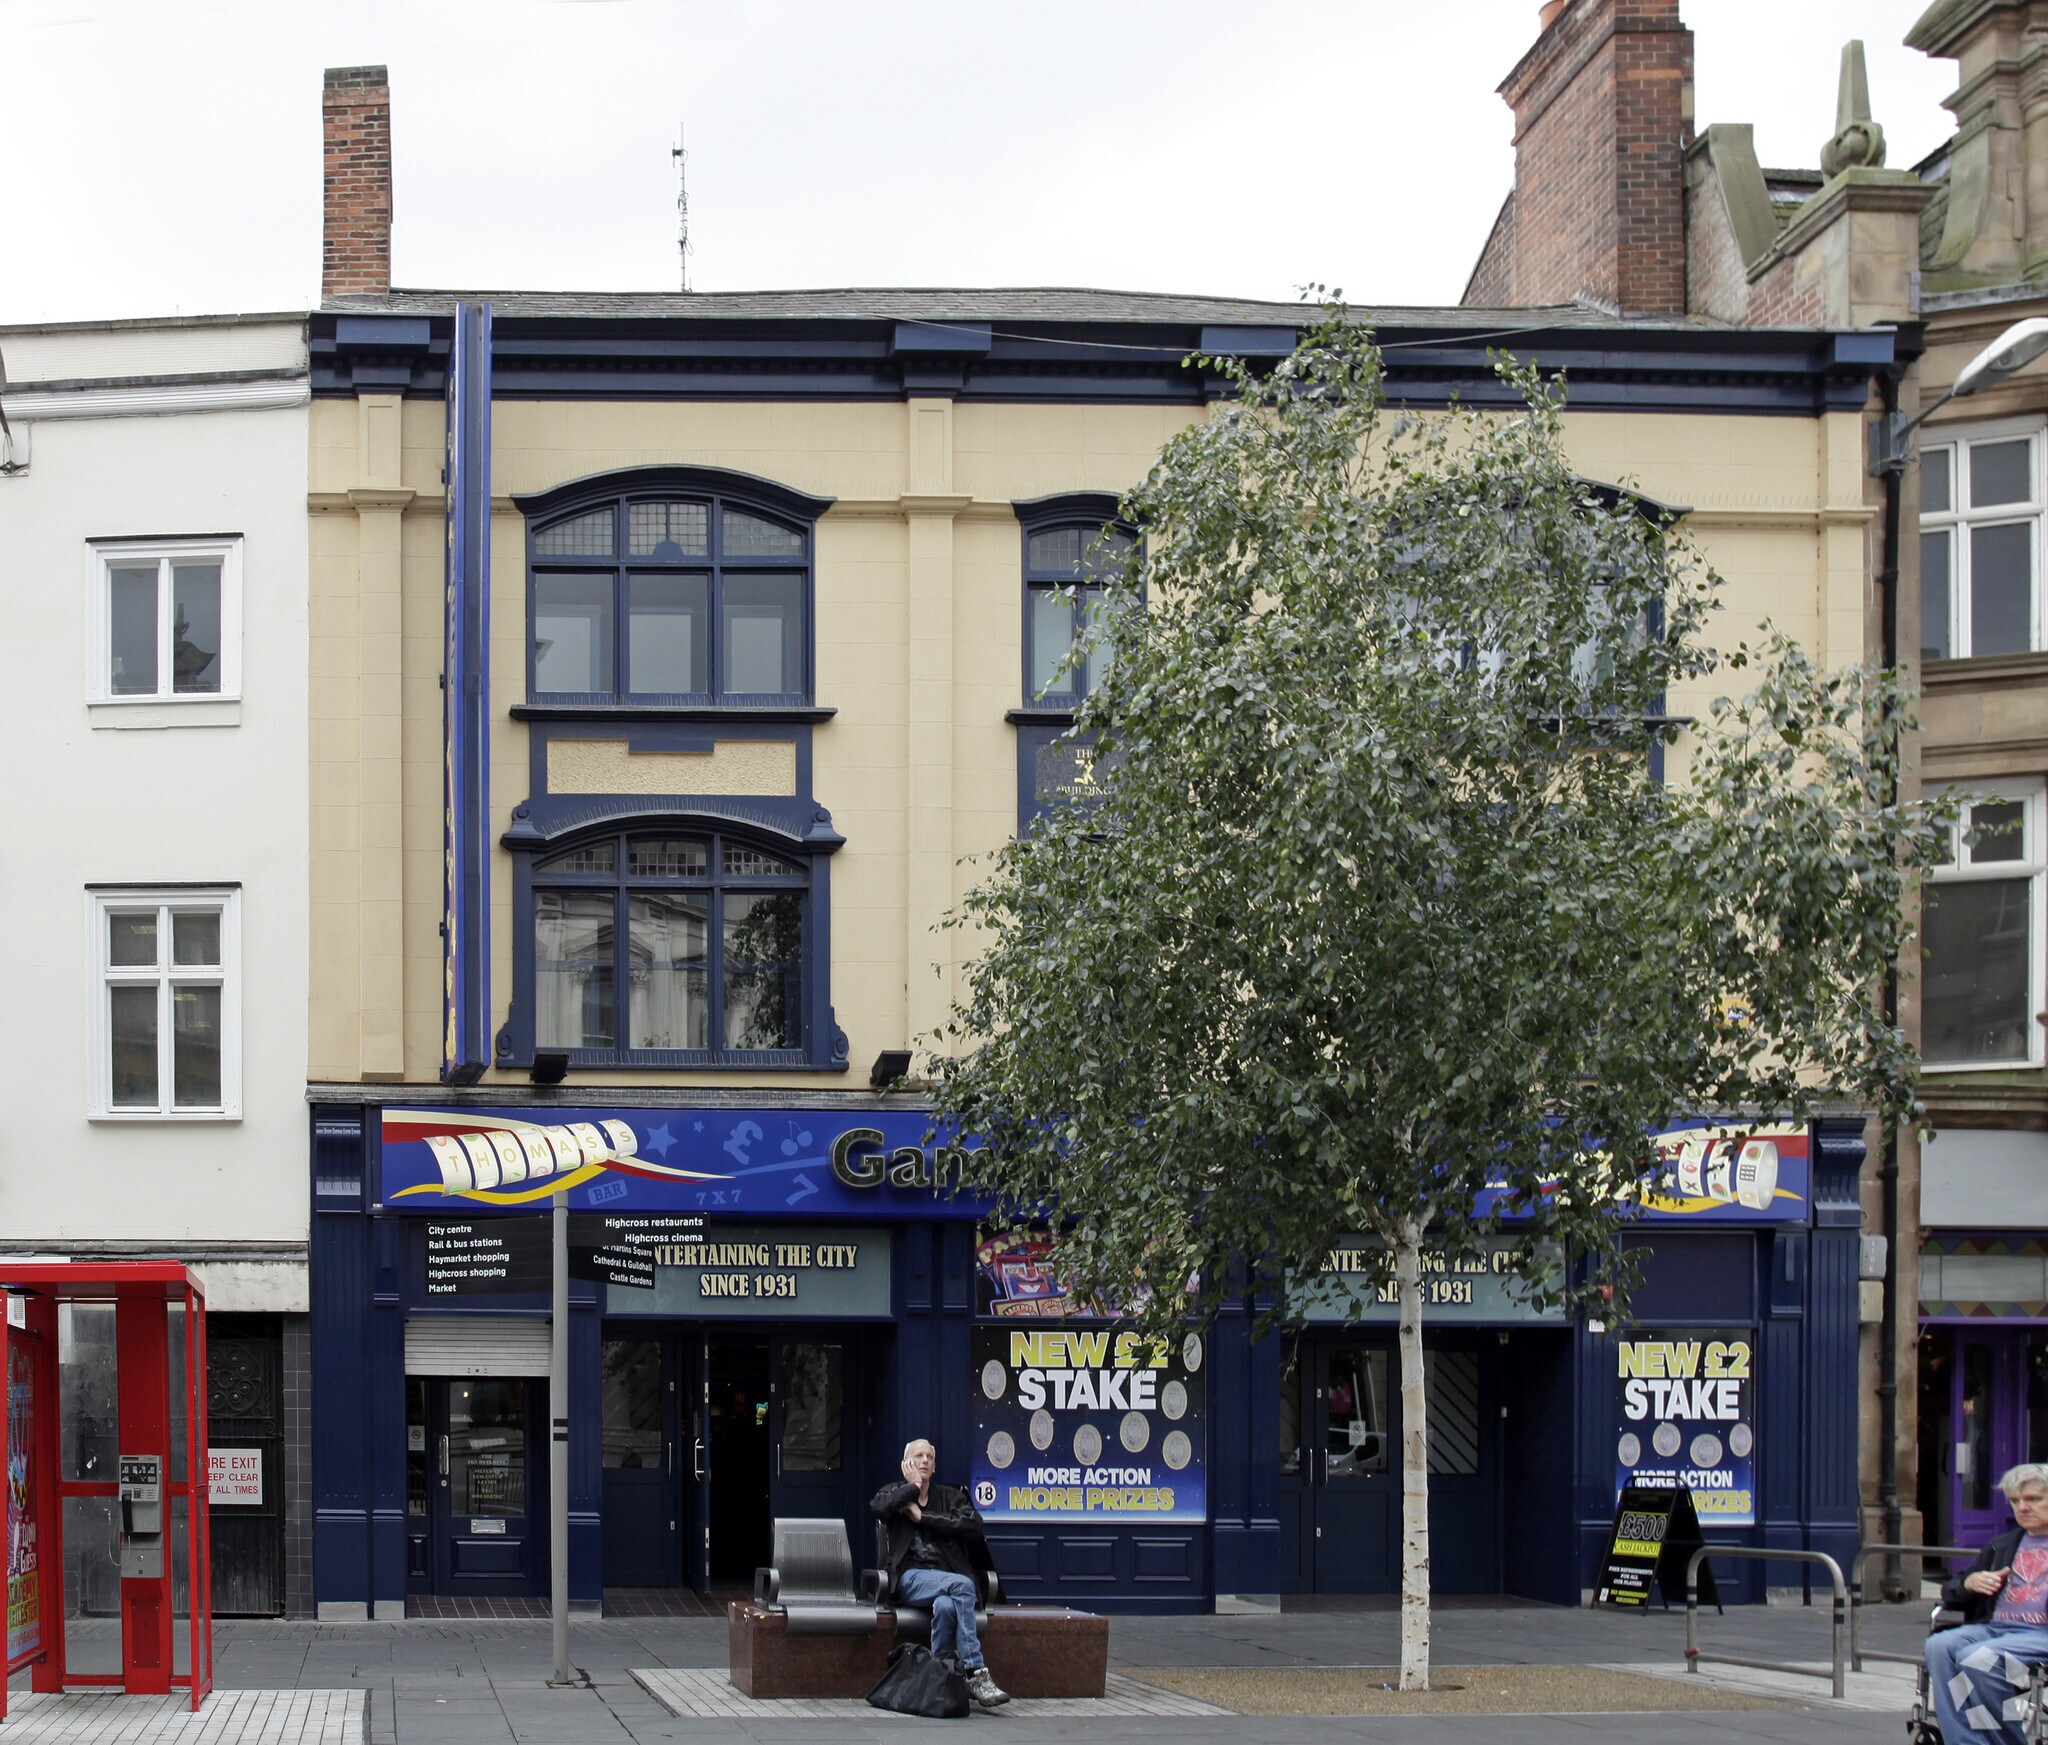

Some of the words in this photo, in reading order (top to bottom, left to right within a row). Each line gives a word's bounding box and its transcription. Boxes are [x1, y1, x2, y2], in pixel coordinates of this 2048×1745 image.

[594, 1183, 624, 1202] BAR
[428, 1226, 445, 1236] City
[446, 1225, 472, 1234] centre
[605, 1218, 649, 1229] Highcross
[651, 1217, 703, 1227] restaurants
[428, 1240, 444, 1249] Rail
[445, 1240, 452, 1249] &
[453, 1239, 468, 1248] bus
[469, 1238, 503, 1247] stations
[625, 1233, 669, 1244] Highcross
[671, 1233, 703, 1242] cinema
[428, 1253, 471, 1264] Haymarket
[472, 1252, 510, 1262] shopping
[632, 1246, 652, 1257] Square
[655, 1244, 770, 1267] NTERTAINING
[775, 1244, 811, 1267] THE
[816, 1245, 858, 1268] CITY
[593, 1254, 621, 1267] Cathedral
[627, 1260, 653, 1272] Guildhall
[1492, 1250, 1531, 1274] CIT
[428, 1269, 468, 1279] Highcross
[469, 1267, 506, 1278] shopping
[609, 1272, 629, 1282] Castle
[629, 1274, 652, 1286] Gardens
[428, 1284, 457, 1293] Market
[700, 1273, 750, 1296] SINCE
[754, 1274, 797, 1297] 1931
[1431, 1280, 1473, 1303] 1931
[1011, 1331, 1110, 1368] NEW
[1618, 1342, 1701, 1378] NEW
[1704, 1341, 1750, 1378] £2
[1017, 1368, 1157, 1411] STAKE
[1624, 1379, 1740, 1420] STAKE
[208, 1457, 226, 1469] IRE
[232, 1457, 258, 1469] EXIT
[208, 1473, 225, 1482] EEP
[229, 1473, 259, 1482] CLEAR
[1027, 1467, 1081, 1485] MORE
[1083, 1467, 1151, 1485] ACTION
[216, 1486, 231, 1494] ALL
[234, 1486, 259, 1495] TIMES
[977, 1486, 993, 1501] 18
[1009, 1487, 1083, 1510] MORE
[1086, 1487, 1175, 1511] PRIZES
[1618, 1513, 1667, 1541] £500
[1614, 1542, 1632, 1551] CASH
